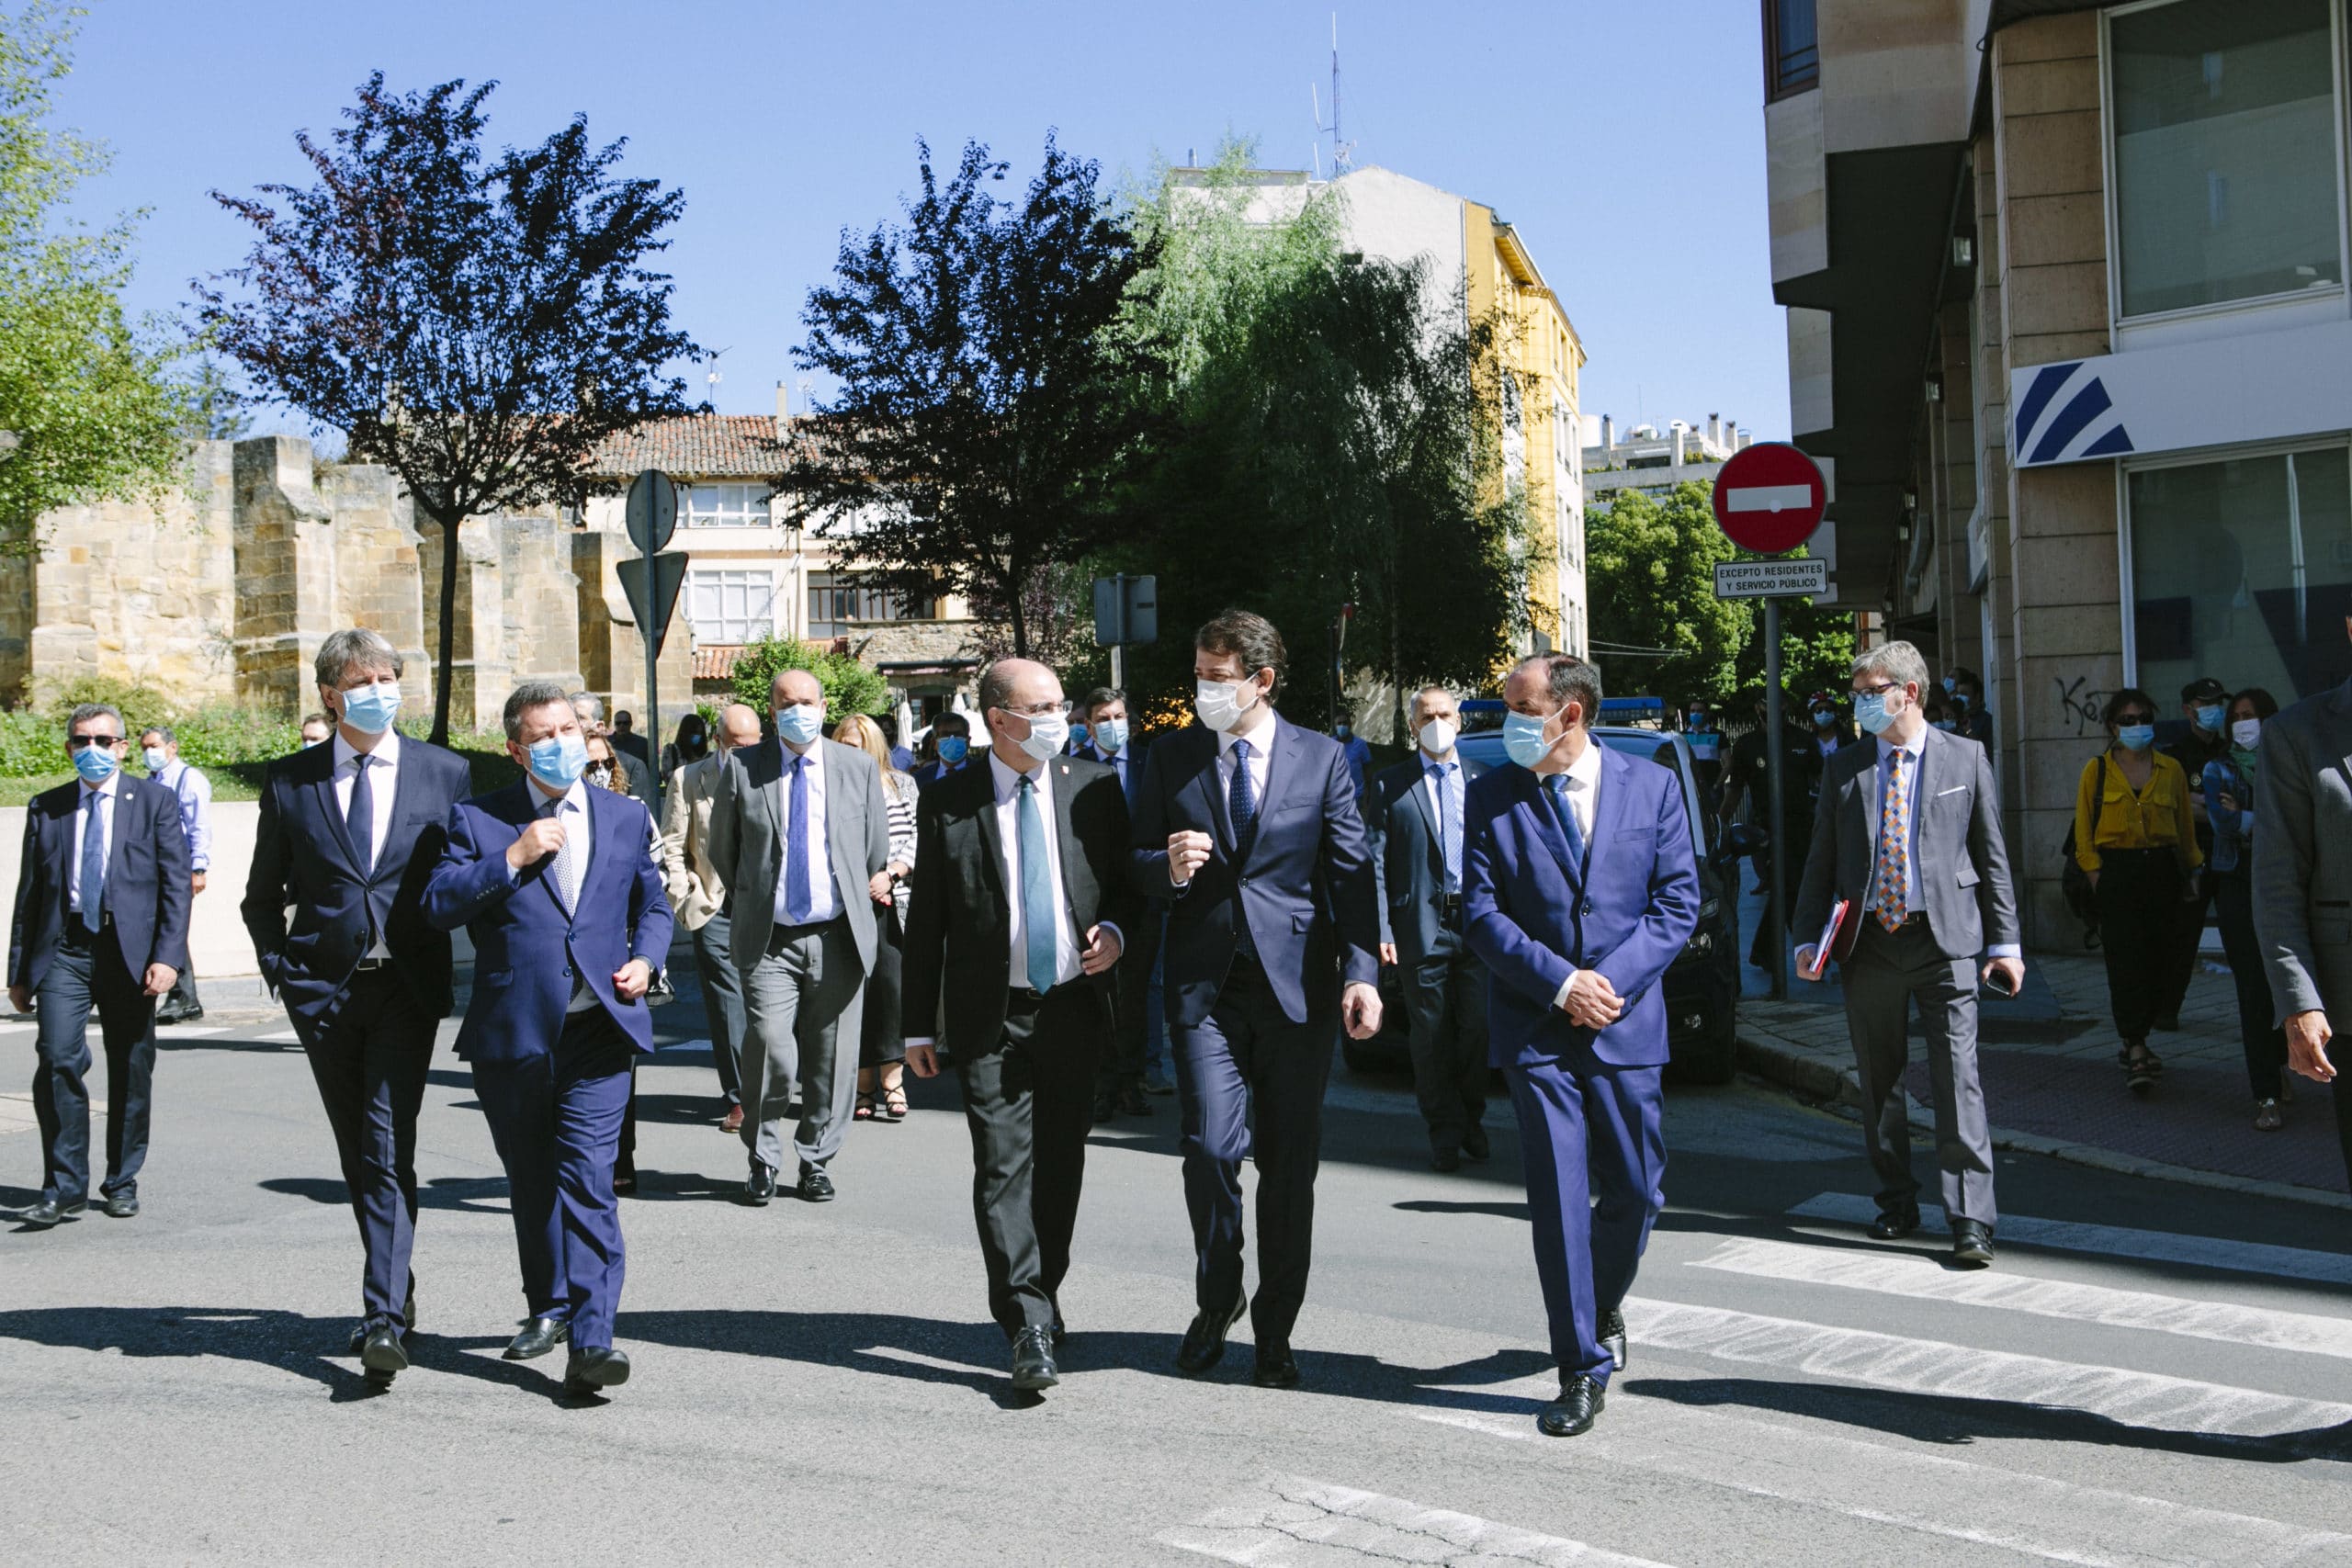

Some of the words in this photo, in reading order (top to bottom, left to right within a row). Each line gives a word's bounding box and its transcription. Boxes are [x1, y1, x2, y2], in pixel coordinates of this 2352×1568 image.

[1720, 568, 1760, 578] EXCEPTO
[1765, 564, 1822, 576] RESIDENTES
[1726, 582, 1732, 591] Y
[1736, 580, 1775, 591] SERVICIO
[1780, 578, 1816, 588] PÚBLICO
